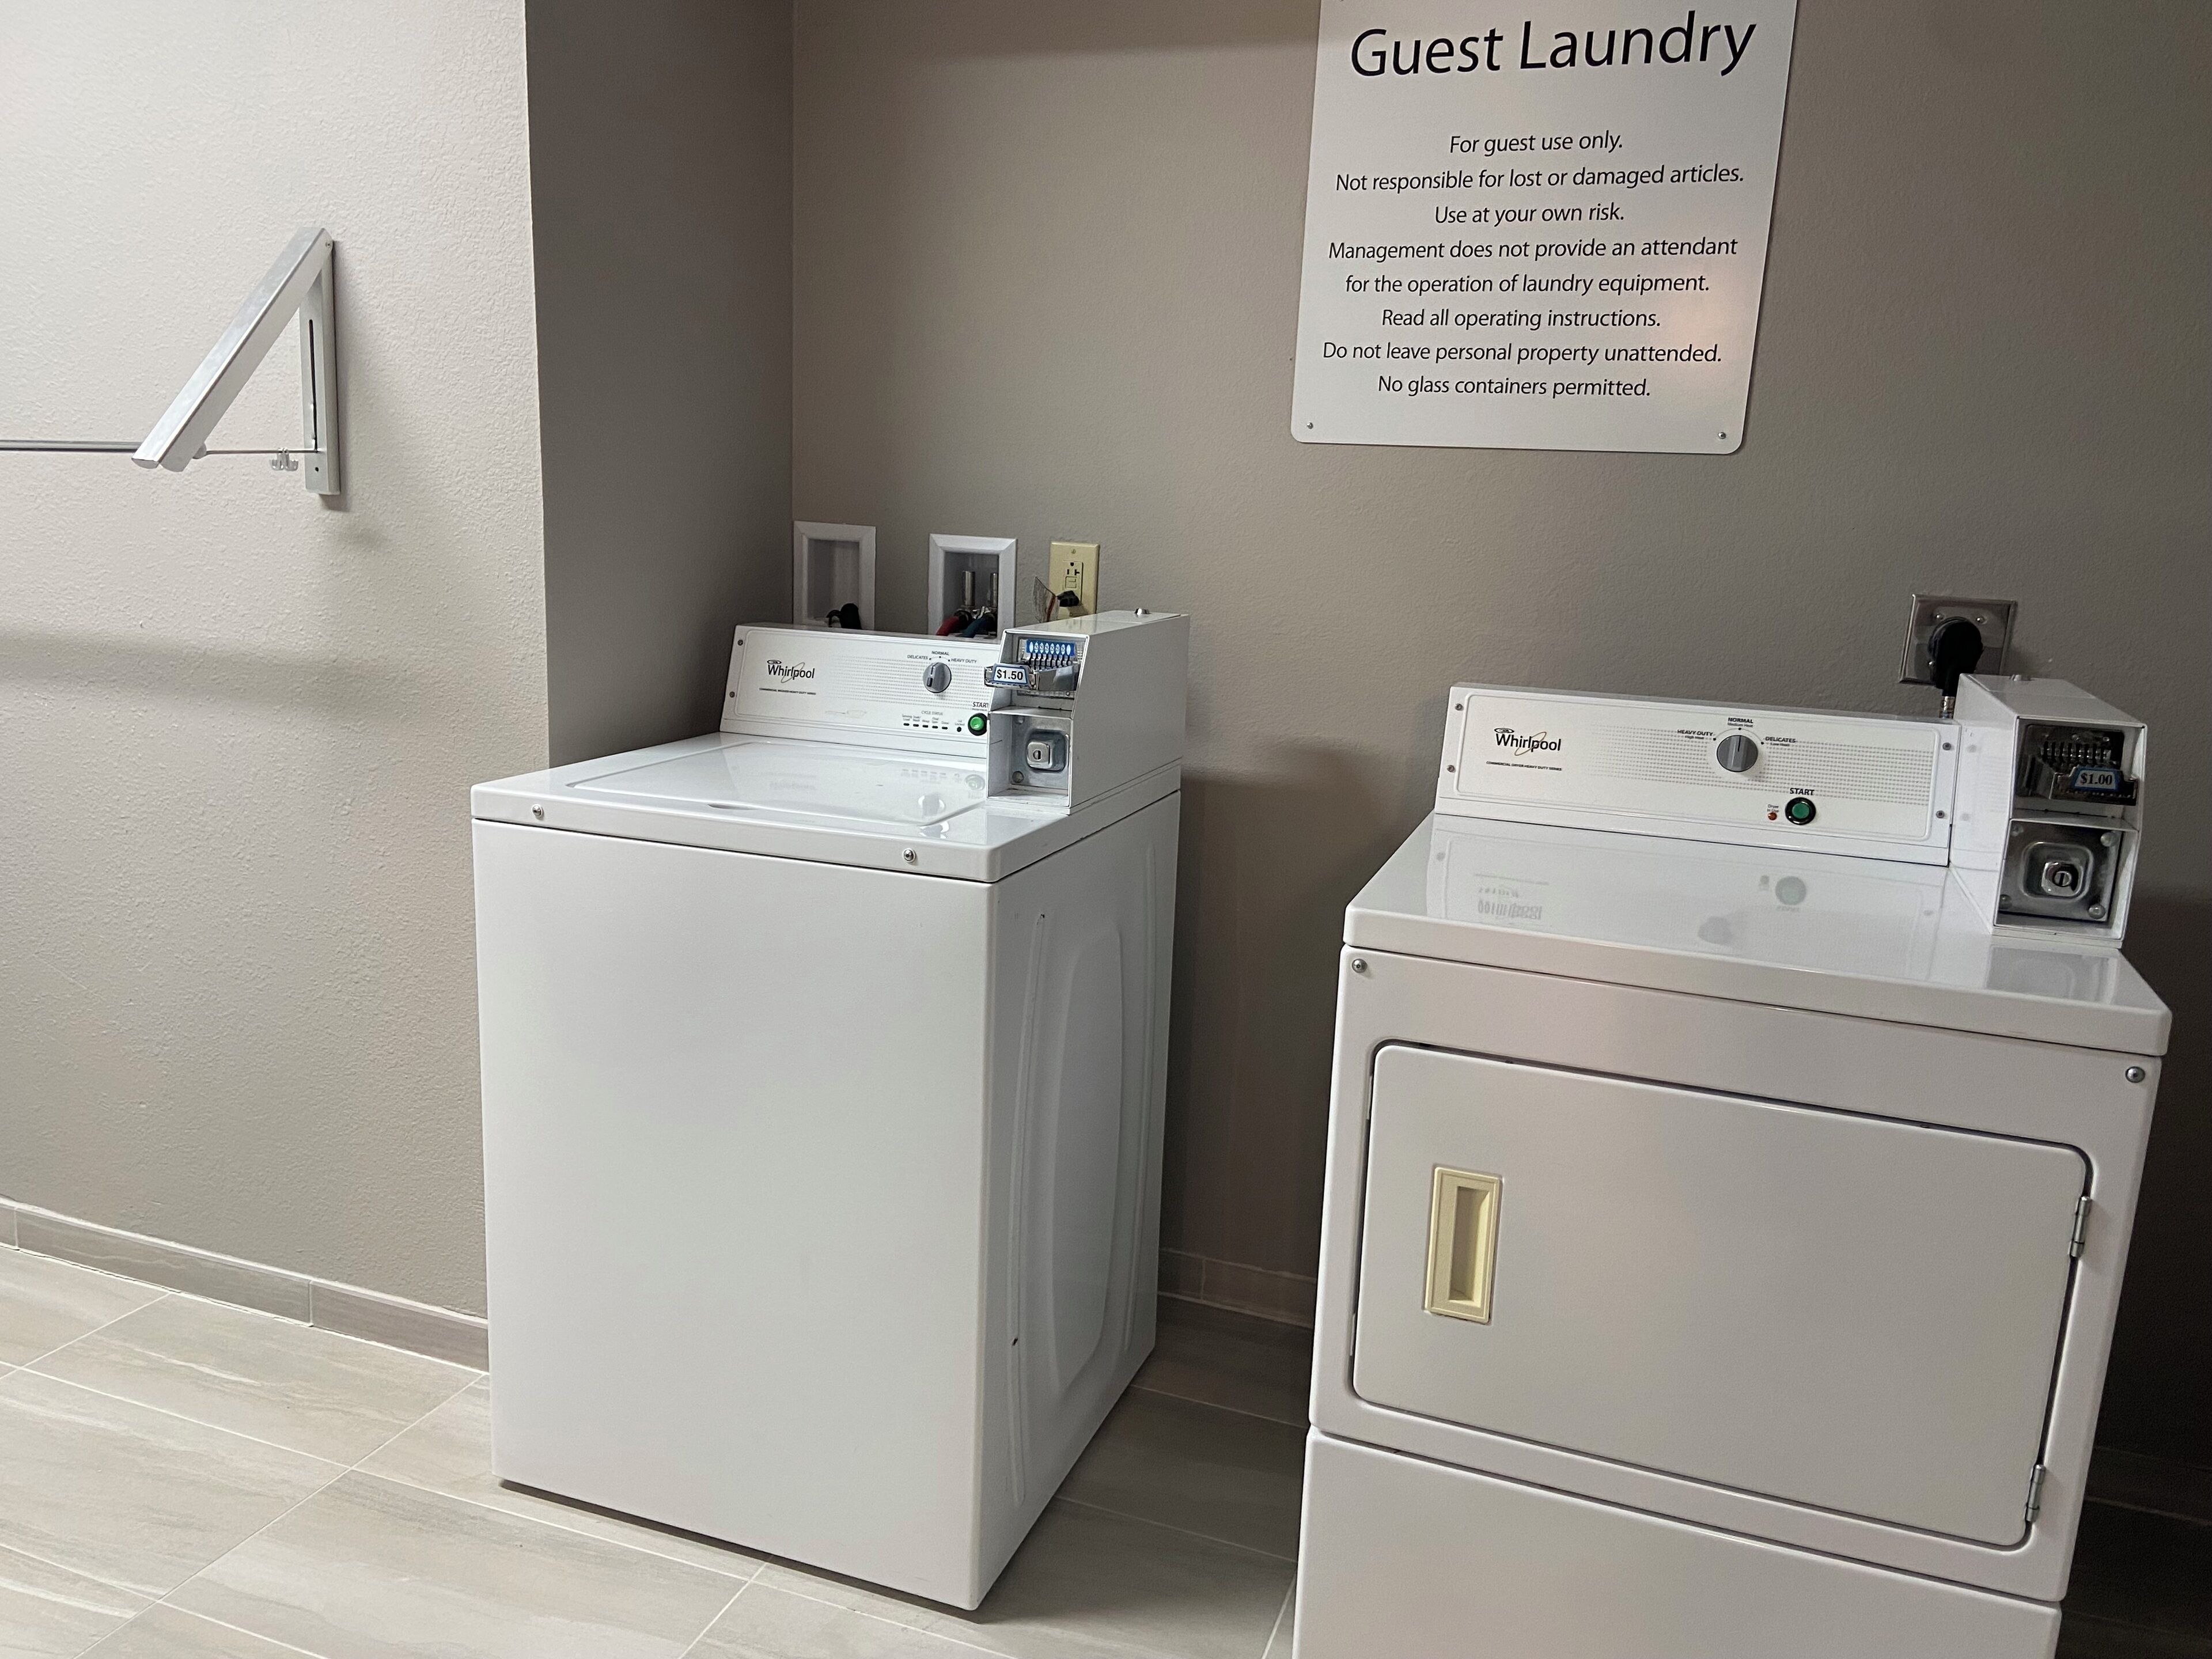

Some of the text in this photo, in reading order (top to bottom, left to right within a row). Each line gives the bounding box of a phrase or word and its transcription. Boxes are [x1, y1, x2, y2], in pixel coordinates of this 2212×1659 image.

[1351, 10, 1756, 76] Guest Laundry
[1450, 130, 1622, 157] For guest use only.
[1336, 163, 1743, 194] Not responsible for lost or damaged articles.
[1435, 202, 1624, 227] Use at your own risk.
[1329, 237, 1738, 263] Management does not provide an attendant
[1346, 274, 1709, 296] for the operation of laundry equipment.
[1382, 309, 1660, 331] Read all operating instructions.
[1324, 342, 1721, 365] Do not leave personal property unattended.
[1378, 376, 1650, 399] No glass containers permitted.
[768, 664, 815, 680] Whirlpool
[997, 669, 1023, 680] $1.50
[1496, 733, 1561, 752] Whirlpool
[2080, 772, 2112, 785] $1.00
[1790, 787, 1815, 796] START
